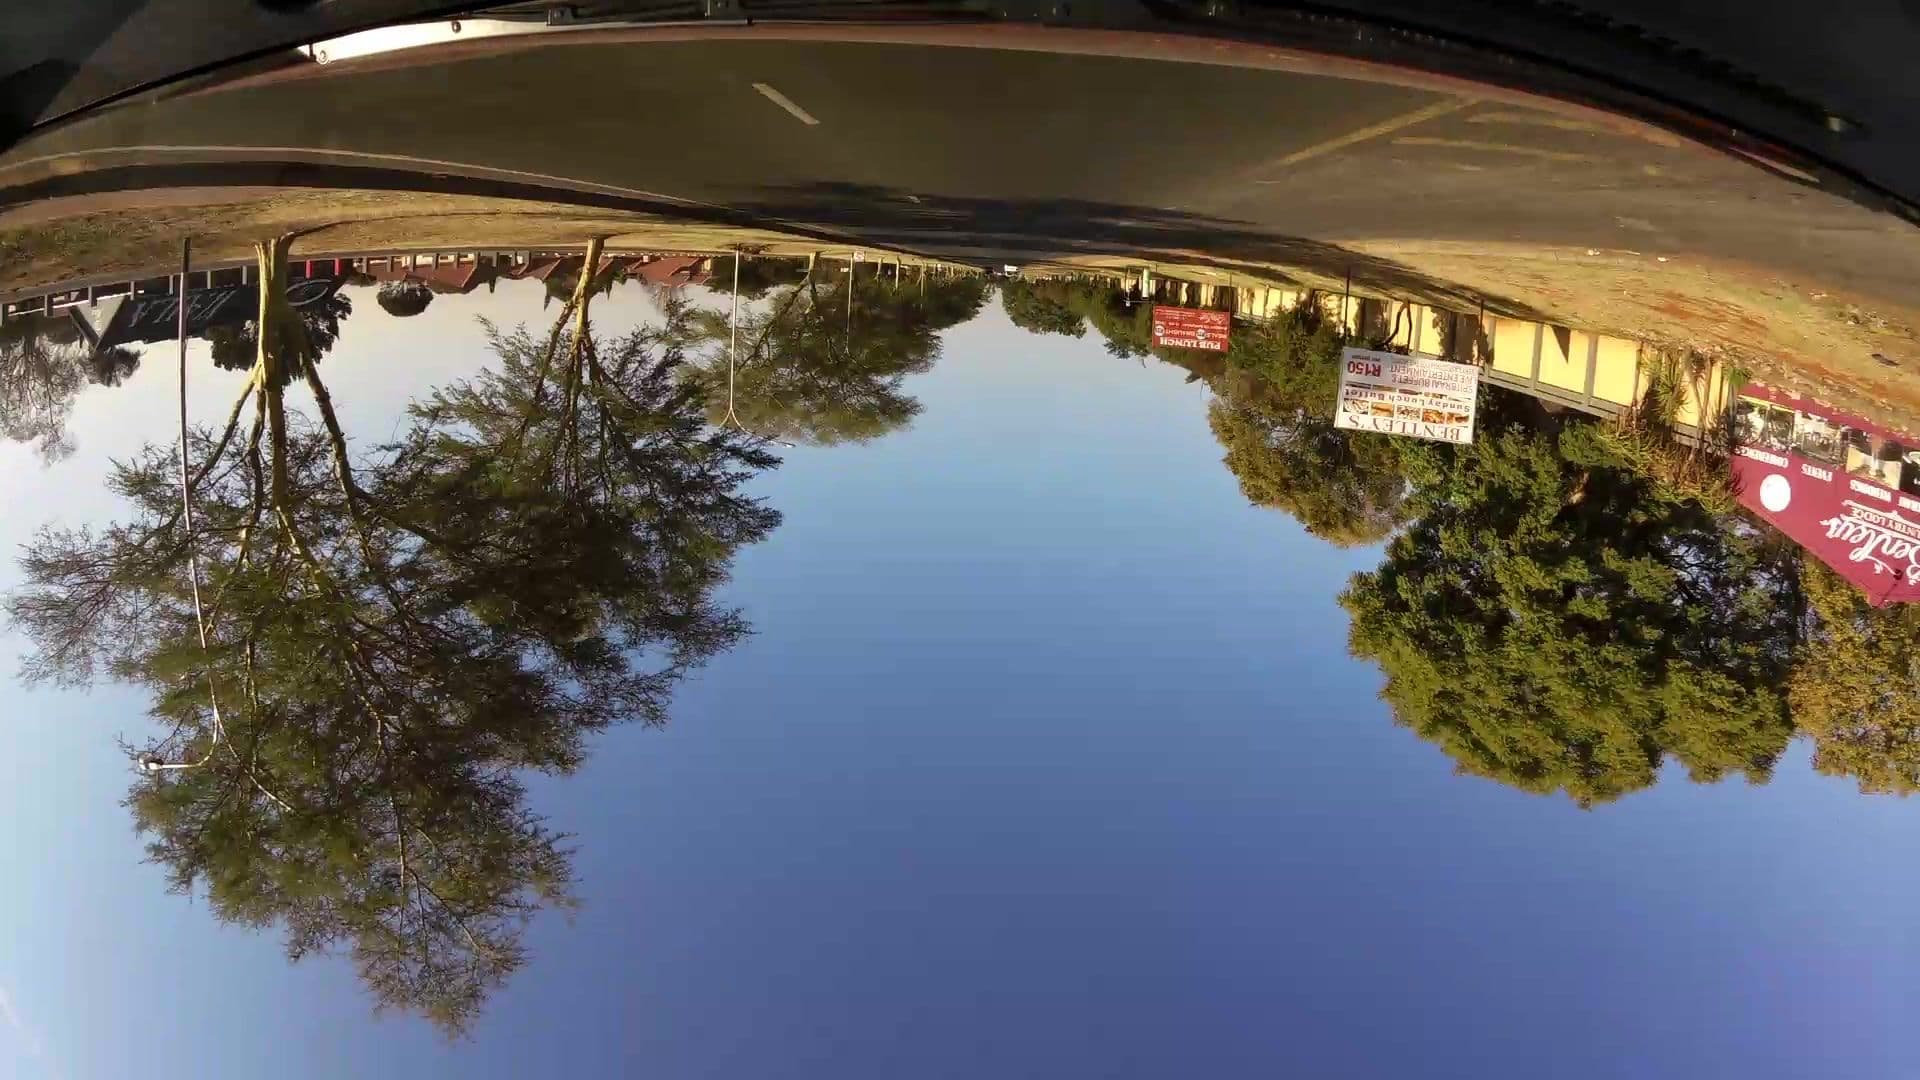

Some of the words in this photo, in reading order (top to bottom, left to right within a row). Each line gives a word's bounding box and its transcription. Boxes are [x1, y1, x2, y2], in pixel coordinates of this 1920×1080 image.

[1160, 337, 1197, 347] LUNCH
[1200, 340, 1220, 350] PUB
[1347, 361, 1381, 377] R150
[1344, 388, 1385, 402] Buffet
[1388, 394, 1425, 406] Lunch
[1428, 399, 1470, 413] Sunday
[1348, 415, 1460, 441] BENTLEY'S
[1851, 507, 1886, 527] LODGE
